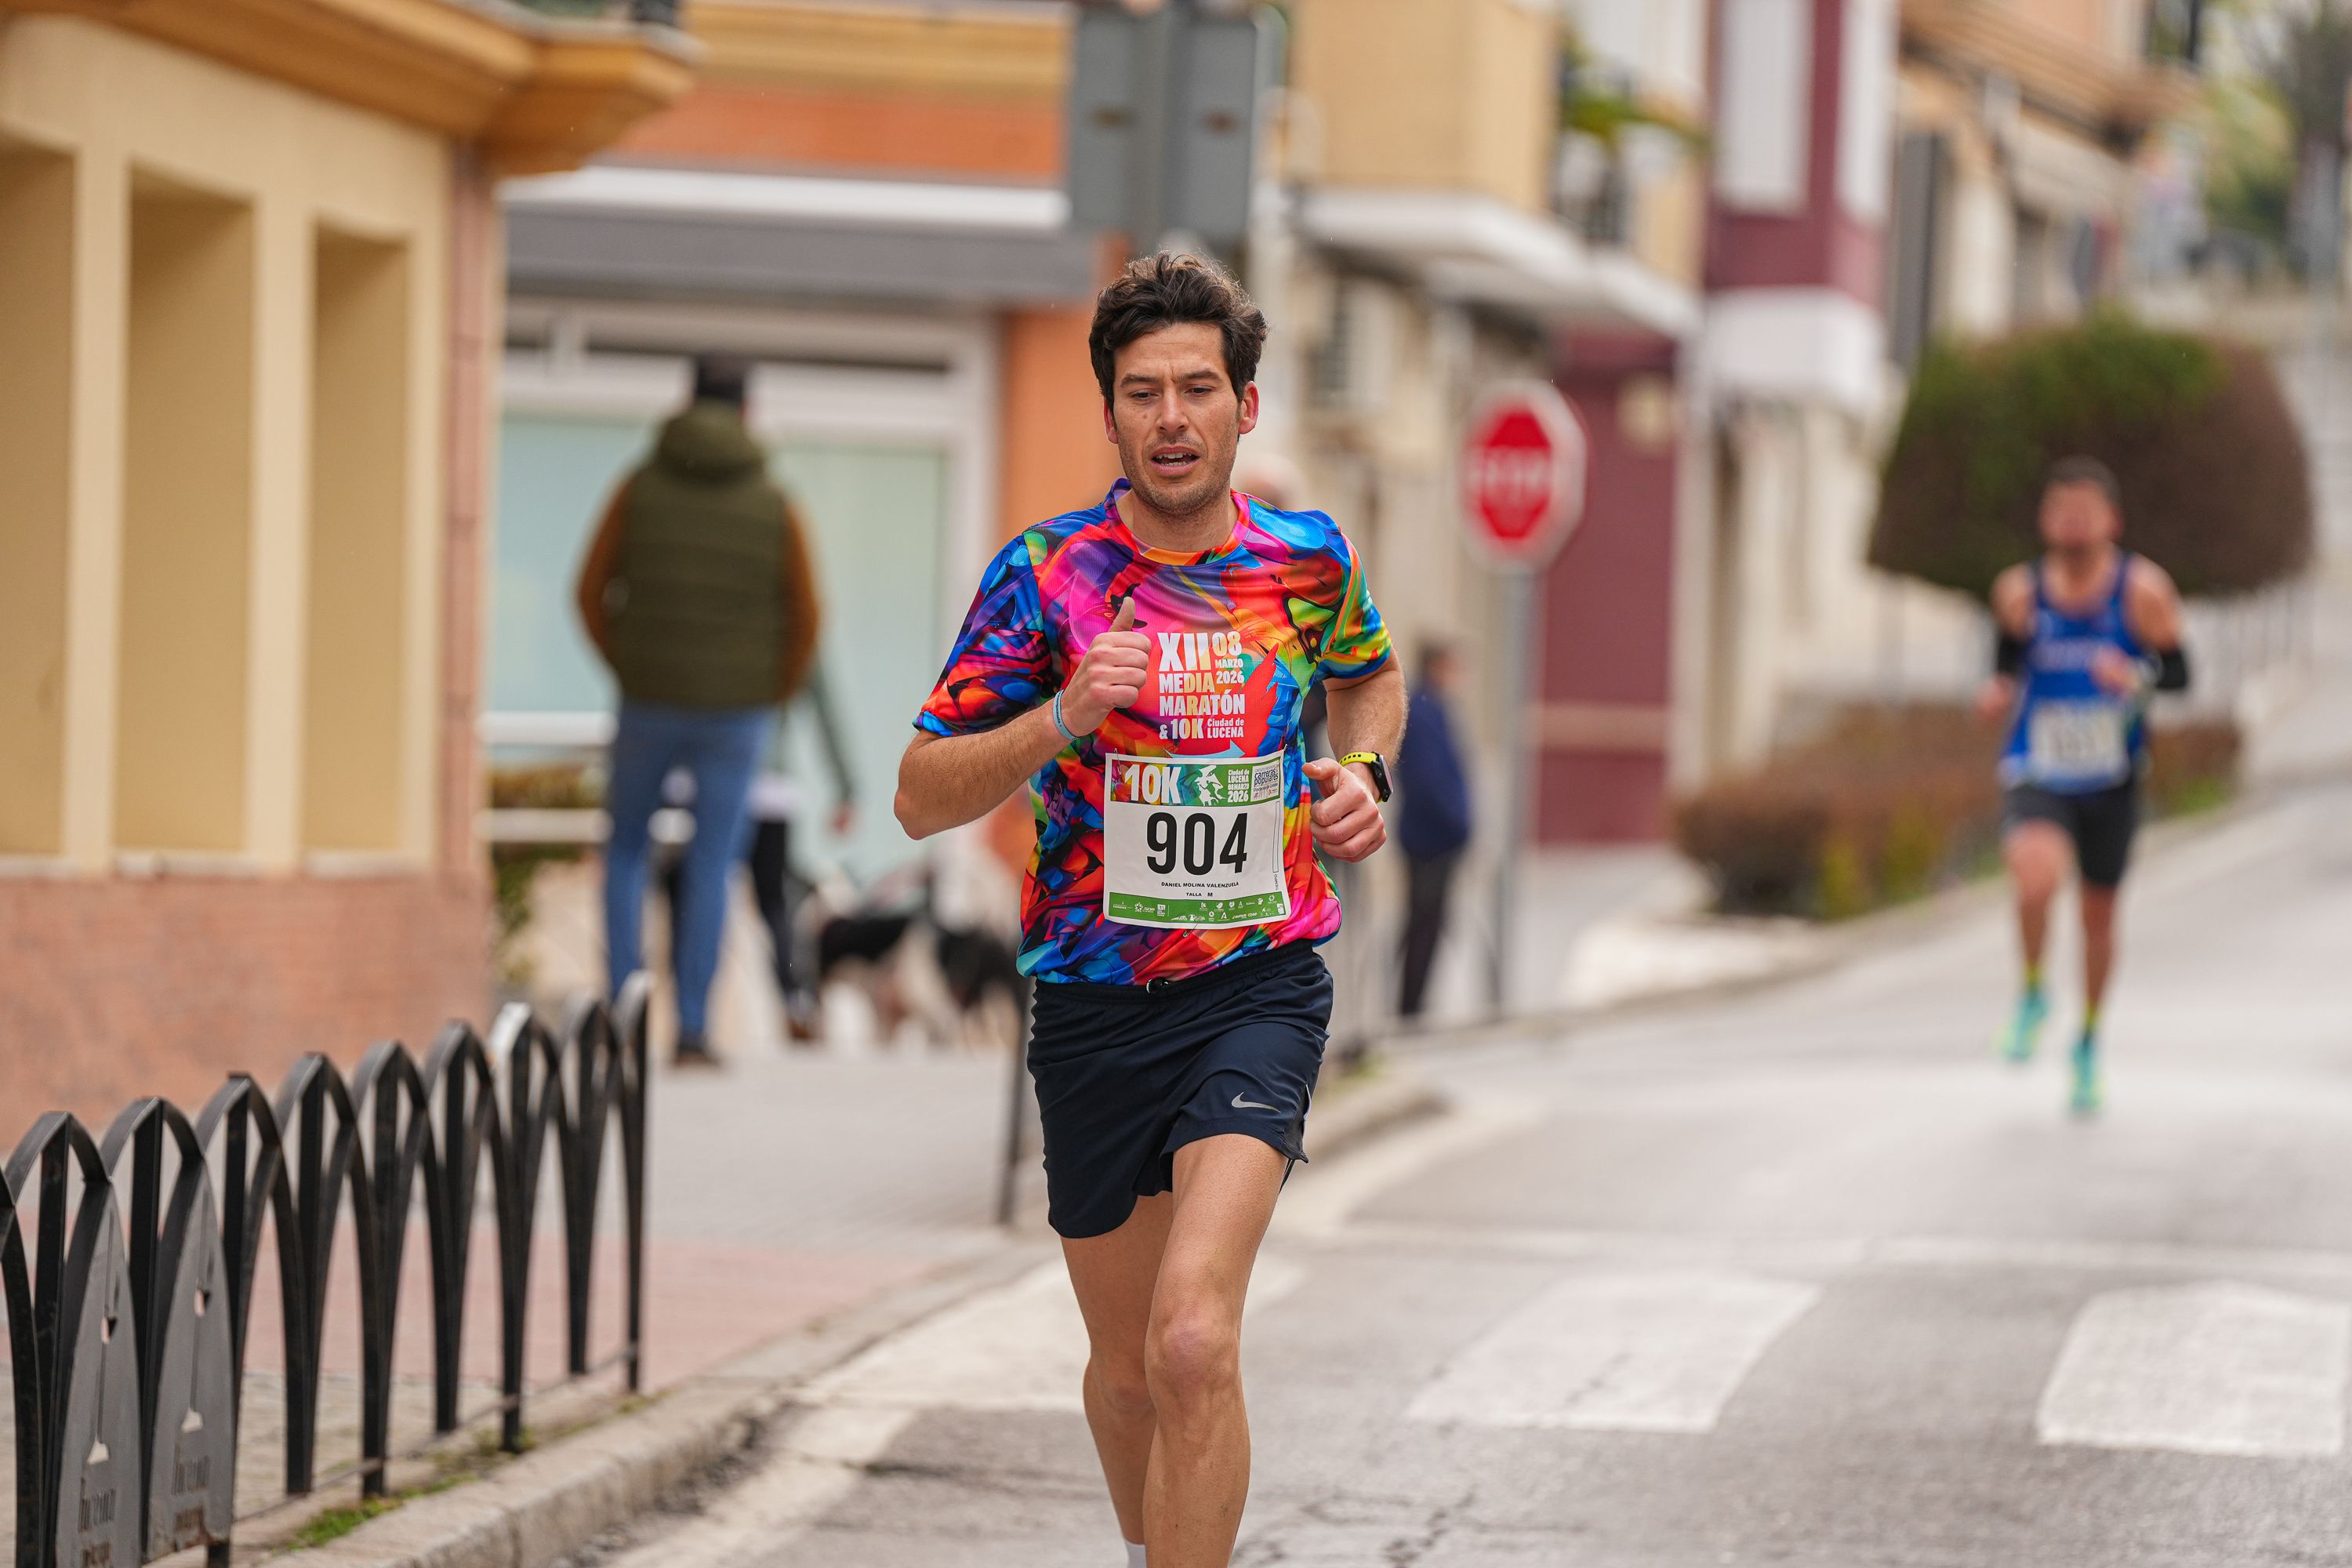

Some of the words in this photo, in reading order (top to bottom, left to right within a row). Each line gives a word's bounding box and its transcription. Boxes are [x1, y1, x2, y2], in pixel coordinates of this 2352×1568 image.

[1211, 630, 1243, 656] 08
[1157, 632, 1211, 672] XII
[1215, 659, 1243, 669] MARZO
[1159, 672, 1215, 694] MEDIA
[1216, 670, 1244, 684] 2026
[1159, 689, 1245, 717] MARATÓN
[1159, 724, 1168, 740] &
[1171, 717, 1204, 739] 10K
[1207, 718, 1233, 727] Ciudad
[1235, 717, 1244, 726] de
[1207, 727, 1244, 739] LUCENA
[1228, 775, 1249, 783] LUCENA
[1254, 768, 1276, 779] carreras
[1254, 773, 1279, 787] populares
[1124, 764, 1181, 804] 10K
[1227, 789, 1249, 803] 2026
[1146, 811, 1248, 876] 904
